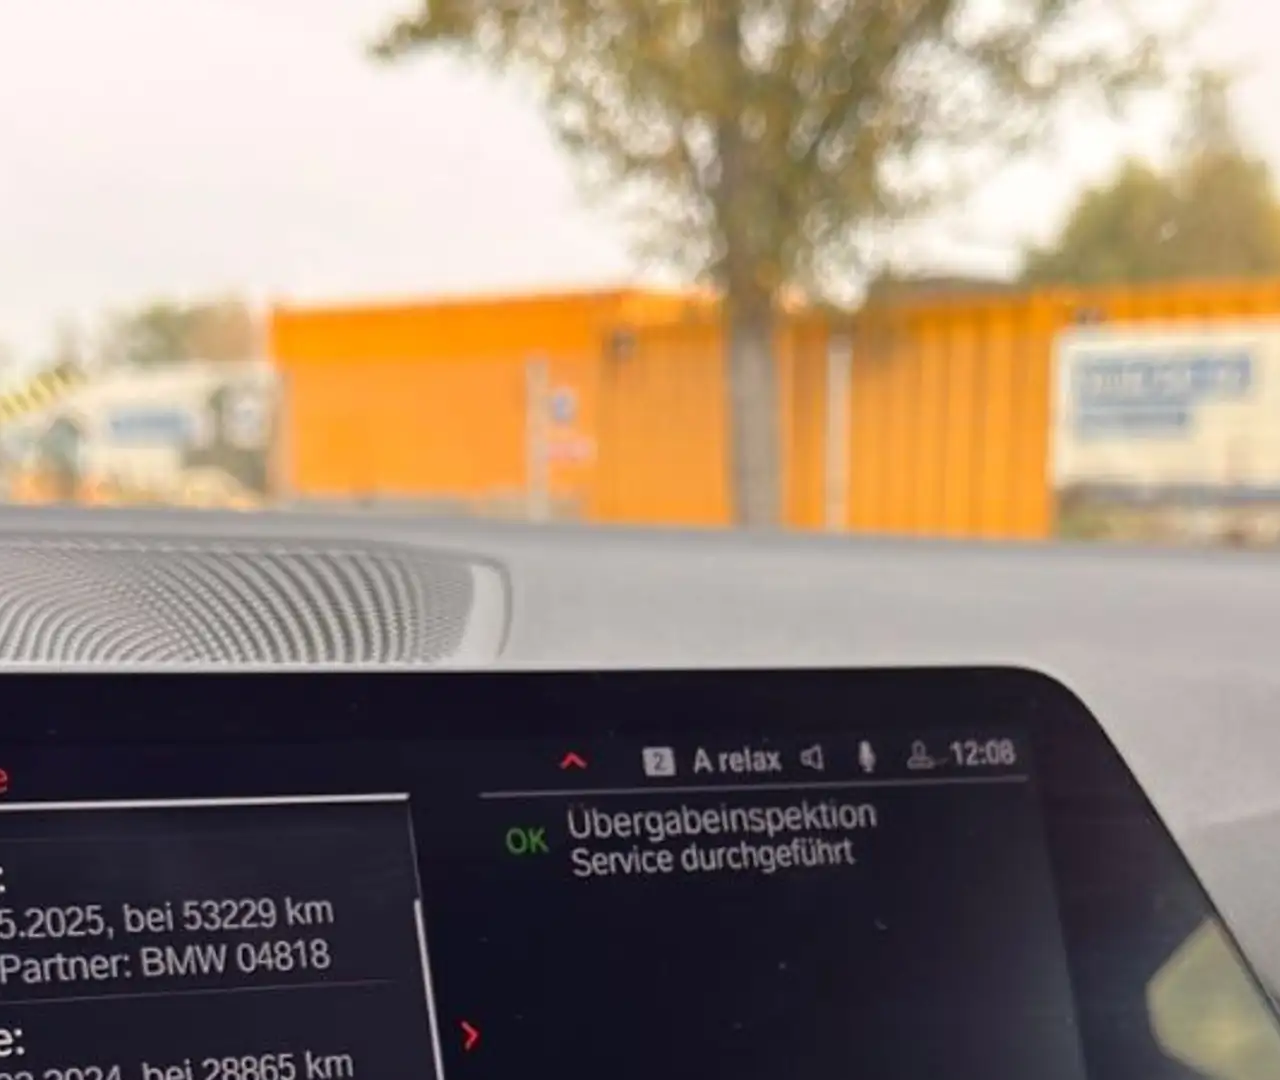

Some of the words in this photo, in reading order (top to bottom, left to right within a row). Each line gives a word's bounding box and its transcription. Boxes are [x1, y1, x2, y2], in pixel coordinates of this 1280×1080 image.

[693, 748, 713, 773] A
[719, 747, 782, 772] relax
[949, 740, 1016, 766] 12:08
[567, 800, 877, 841] Übergabeinspektion
[506, 828, 548, 854] OK
[572, 845, 674, 876] Service
[681, 838, 856, 874] durchgeführt
[124, 902, 175, 934] bei
[183, 897, 279, 932] 53229
[286, 894, 334, 926] km
[141, 944, 227, 977] BMW
[236, 939, 331, 972] 04818
[305, 1048, 353, 1080] km
